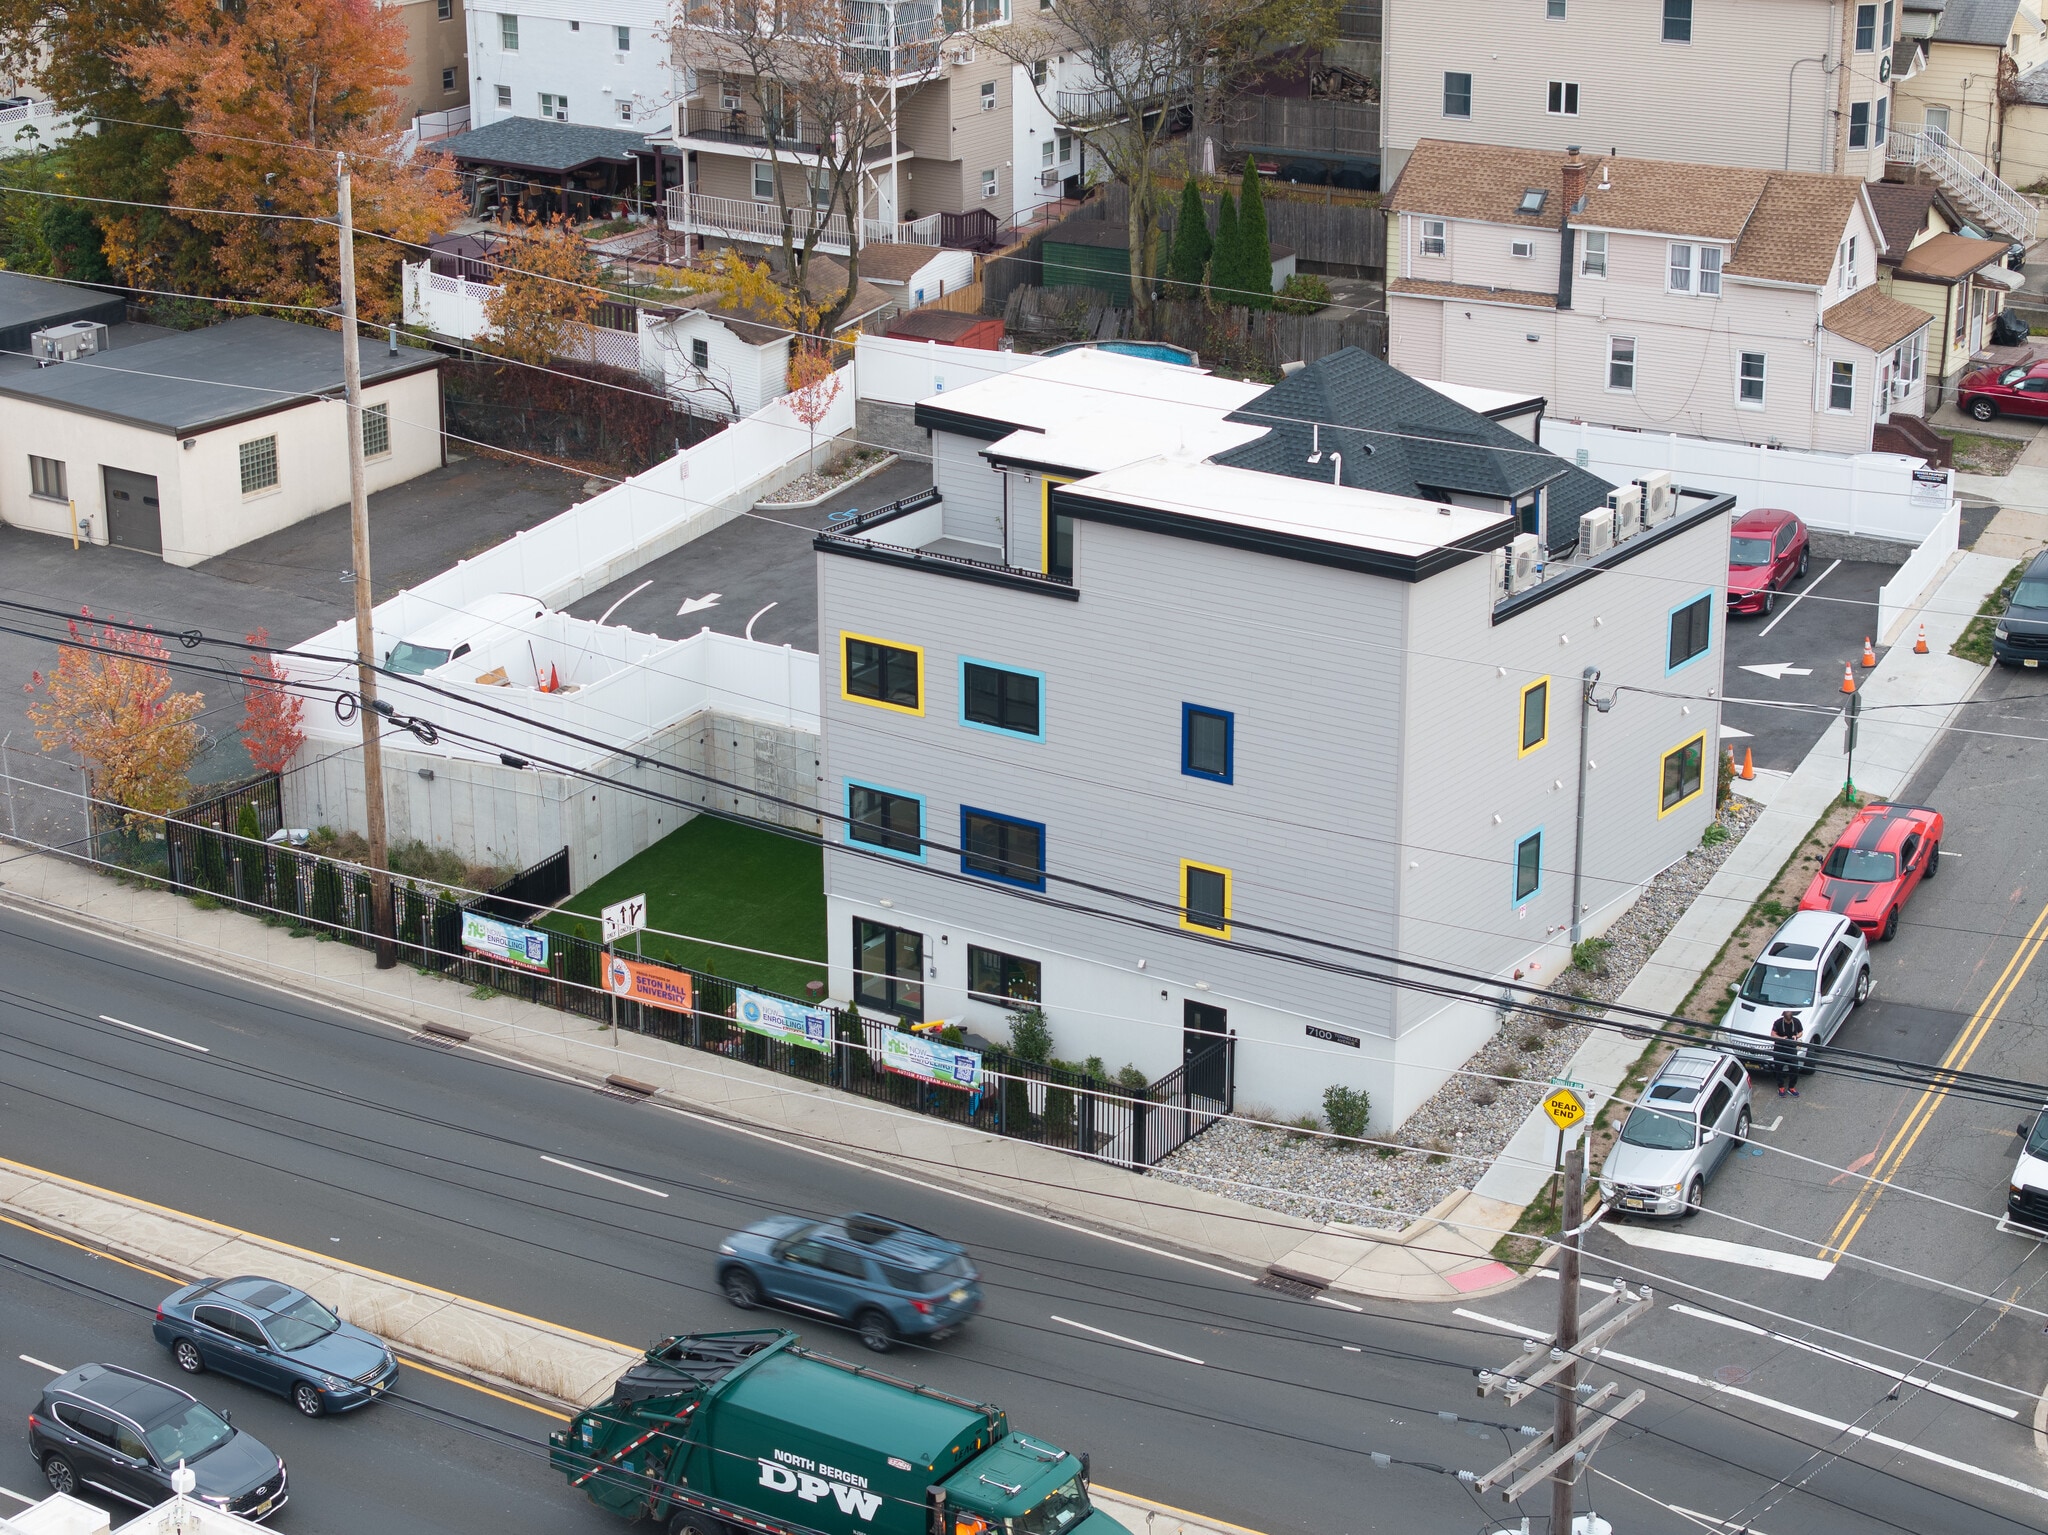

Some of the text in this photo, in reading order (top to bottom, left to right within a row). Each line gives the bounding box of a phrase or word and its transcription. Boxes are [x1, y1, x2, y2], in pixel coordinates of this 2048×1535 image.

[487, 928, 502, 938] NOW
[487, 935, 525, 950] ENROLLING!
[636, 975, 686, 996] SETON HALL
[636, 984, 686, 1004] UNIVERSITY
[762, 1006, 779, 1017] NOW
[763, 1014, 805, 1031] ENROLLING!
[1308, 1027, 1332, 1040] 7100
[909, 1045, 927, 1056] NOW
[897, 1069, 915, 1078] AUTISM
[916, 1074, 941, 1084] PROGRAM
[1551, 1100, 1577, 1112] DEAD
[1553, 1109, 1574, 1119] END
[774, 1449, 868, 1489] NORTH BERGEN
[758, 1457, 882, 1521] DPW
